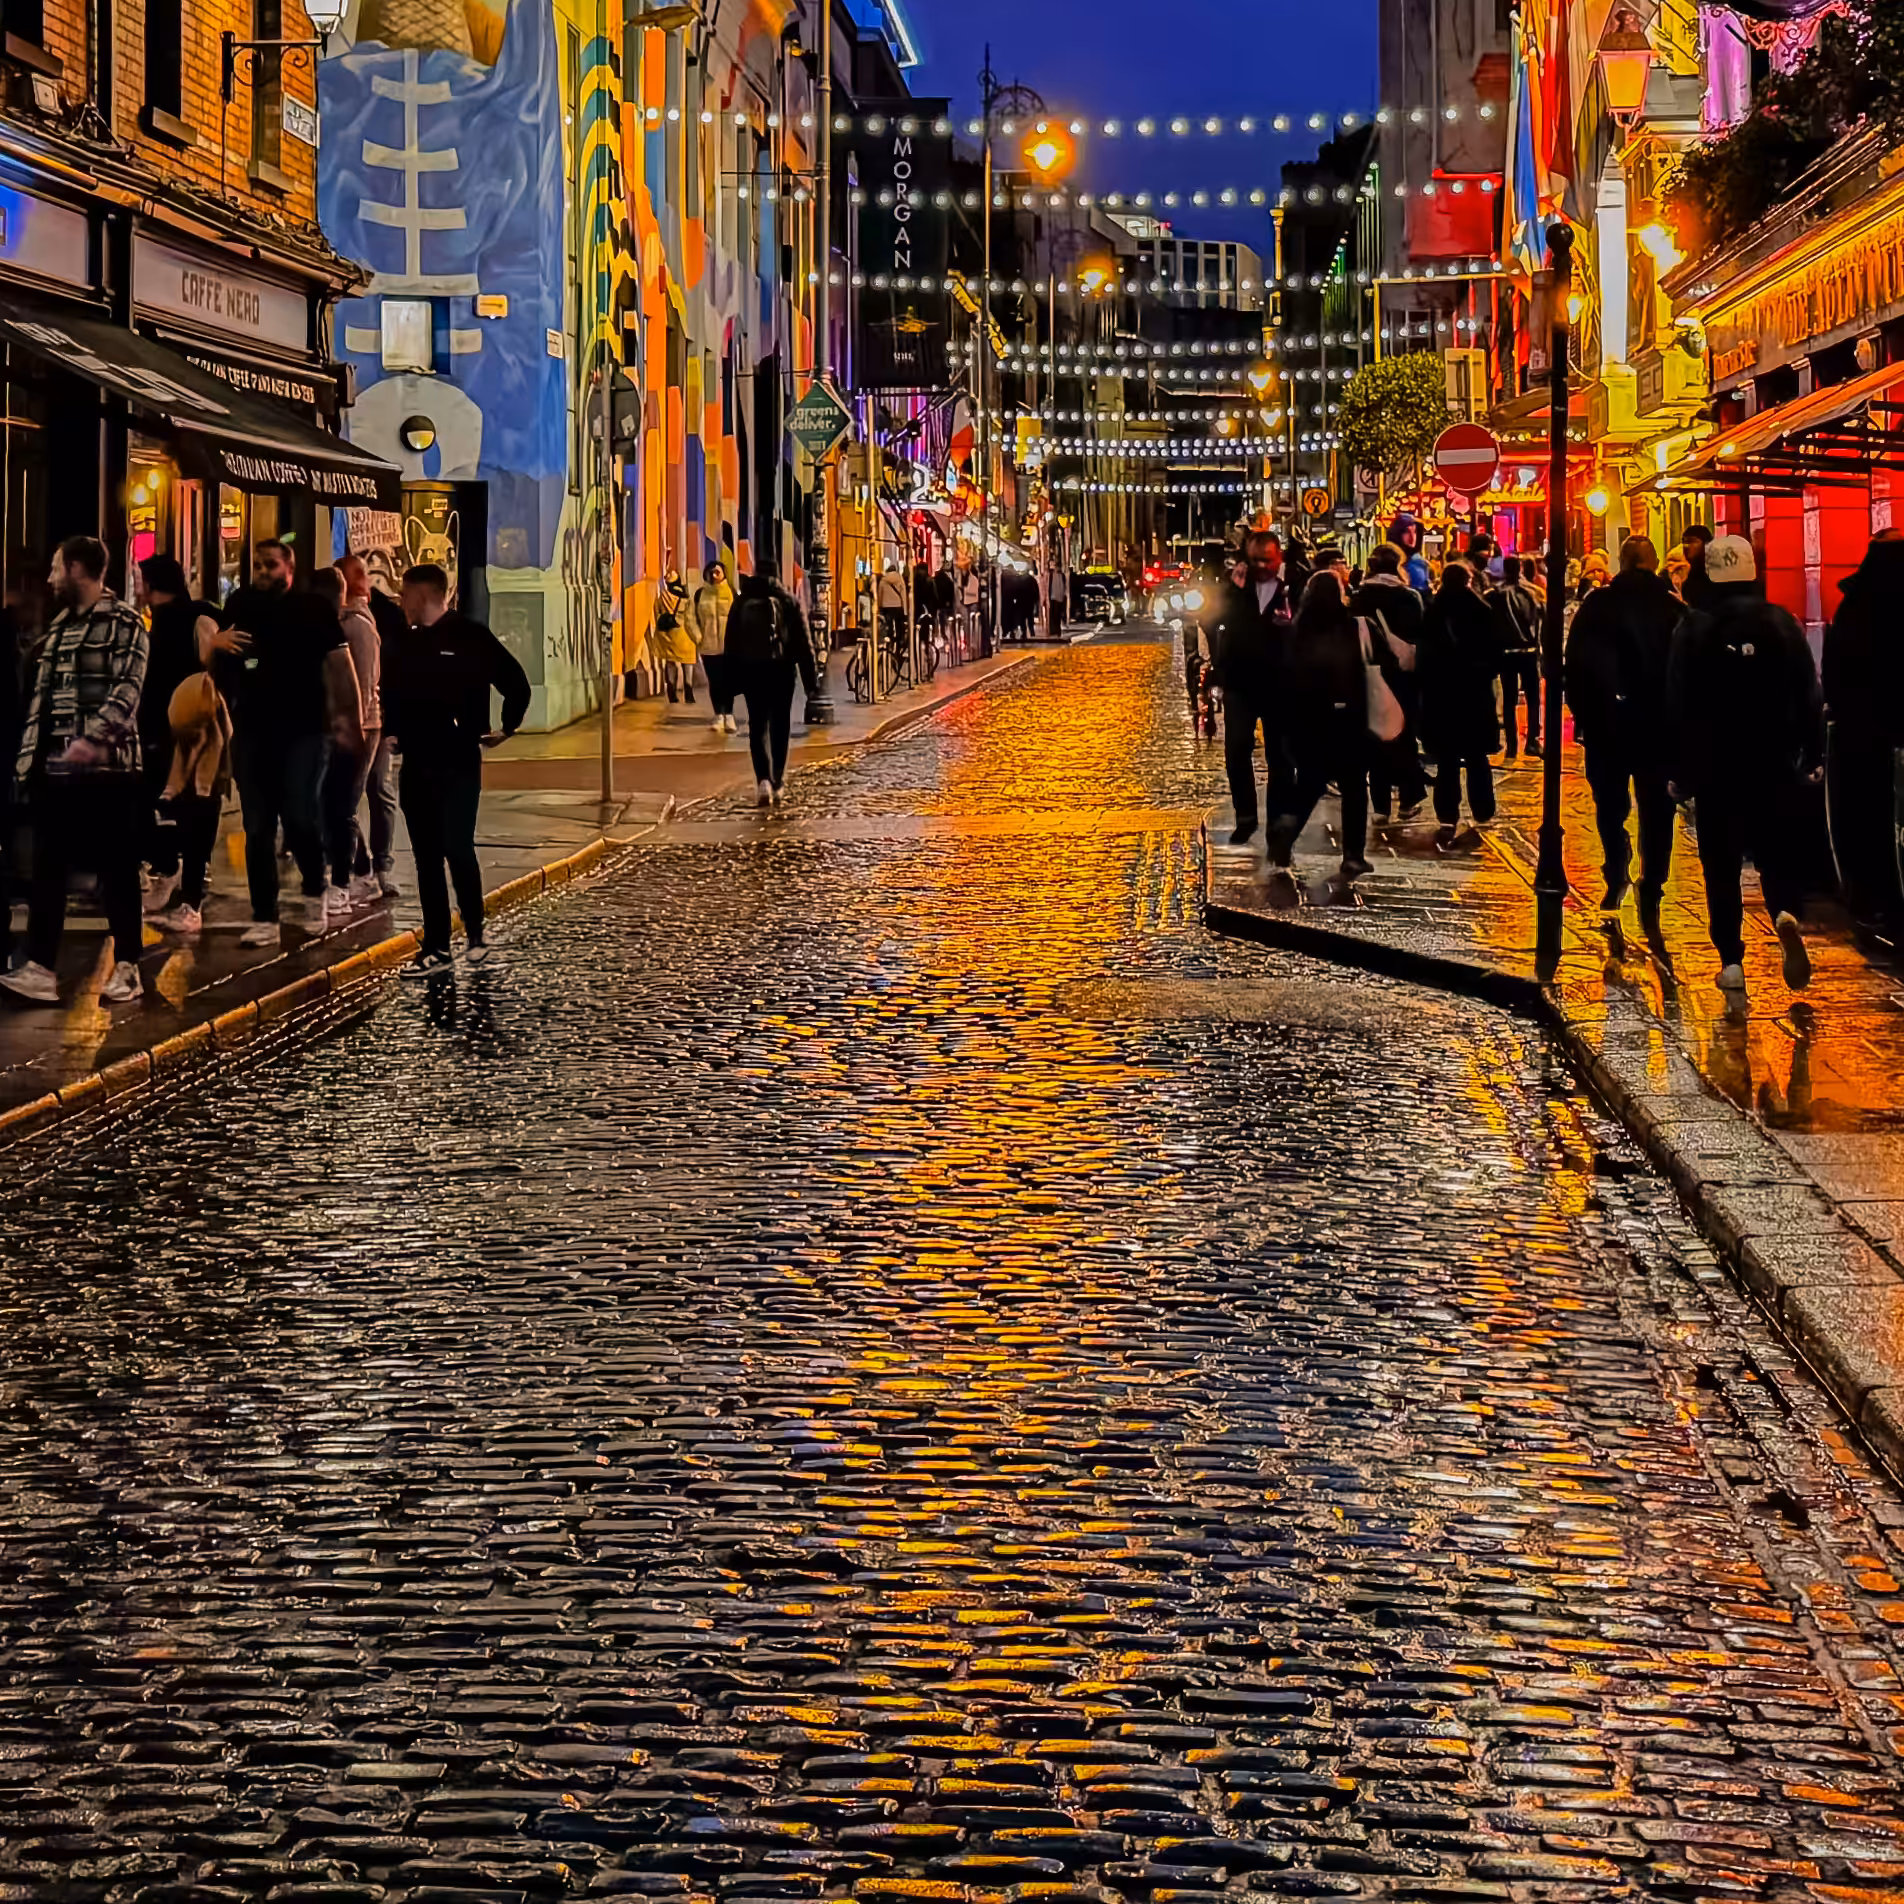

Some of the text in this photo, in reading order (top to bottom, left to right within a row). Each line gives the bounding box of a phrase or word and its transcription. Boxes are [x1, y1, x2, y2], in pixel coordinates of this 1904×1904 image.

[893, 136, 913, 269] MORGAN
[226, 287, 260, 325] NERO
[796, 406, 840, 421] greens
